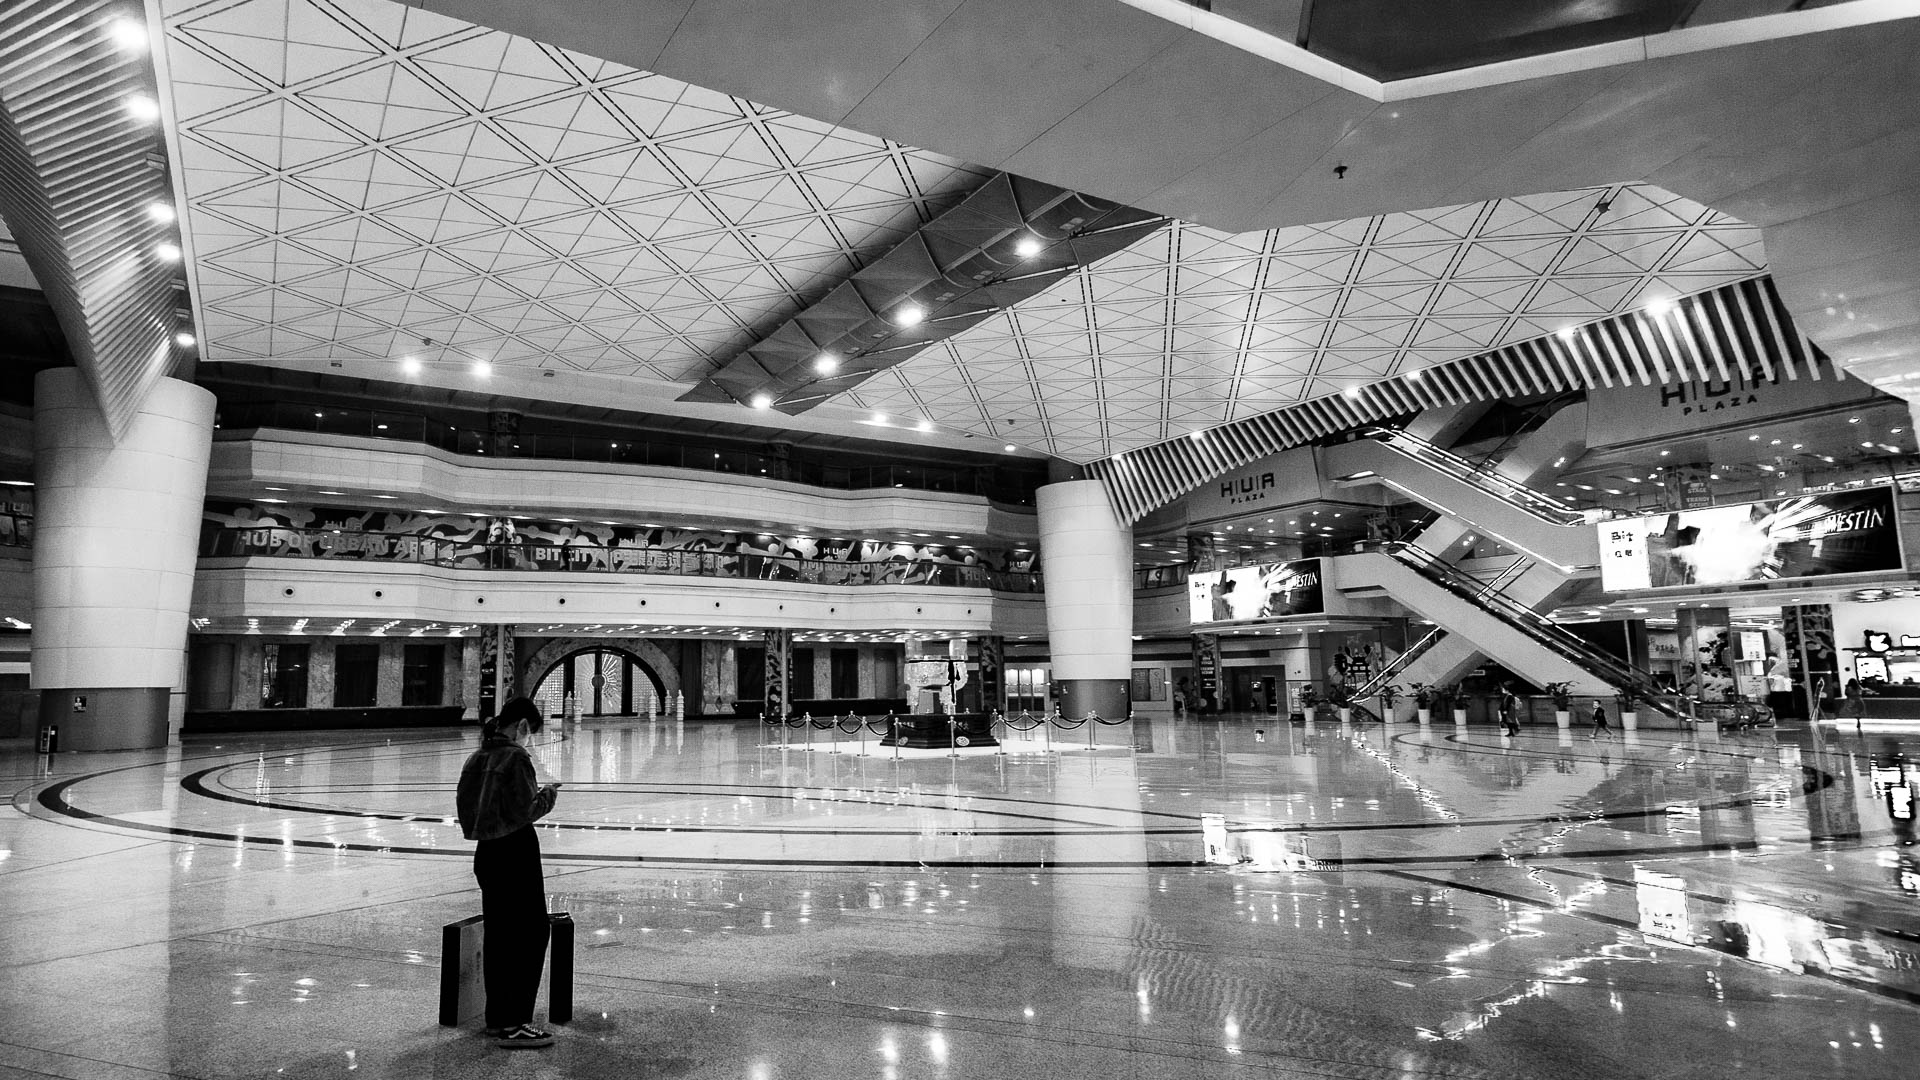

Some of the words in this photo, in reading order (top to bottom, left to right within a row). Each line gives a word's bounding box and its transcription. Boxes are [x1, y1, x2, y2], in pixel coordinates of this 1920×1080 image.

[1683, 394, 1758, 416] PLAZA
[1230, 492, 1265, 504] PLAZA
[240, 531, 282, 547] HUB
[287, 535, 313, 548] OF
[319, 535, 390, 554] URBAN
[535, 547, 562, 561] BIT
